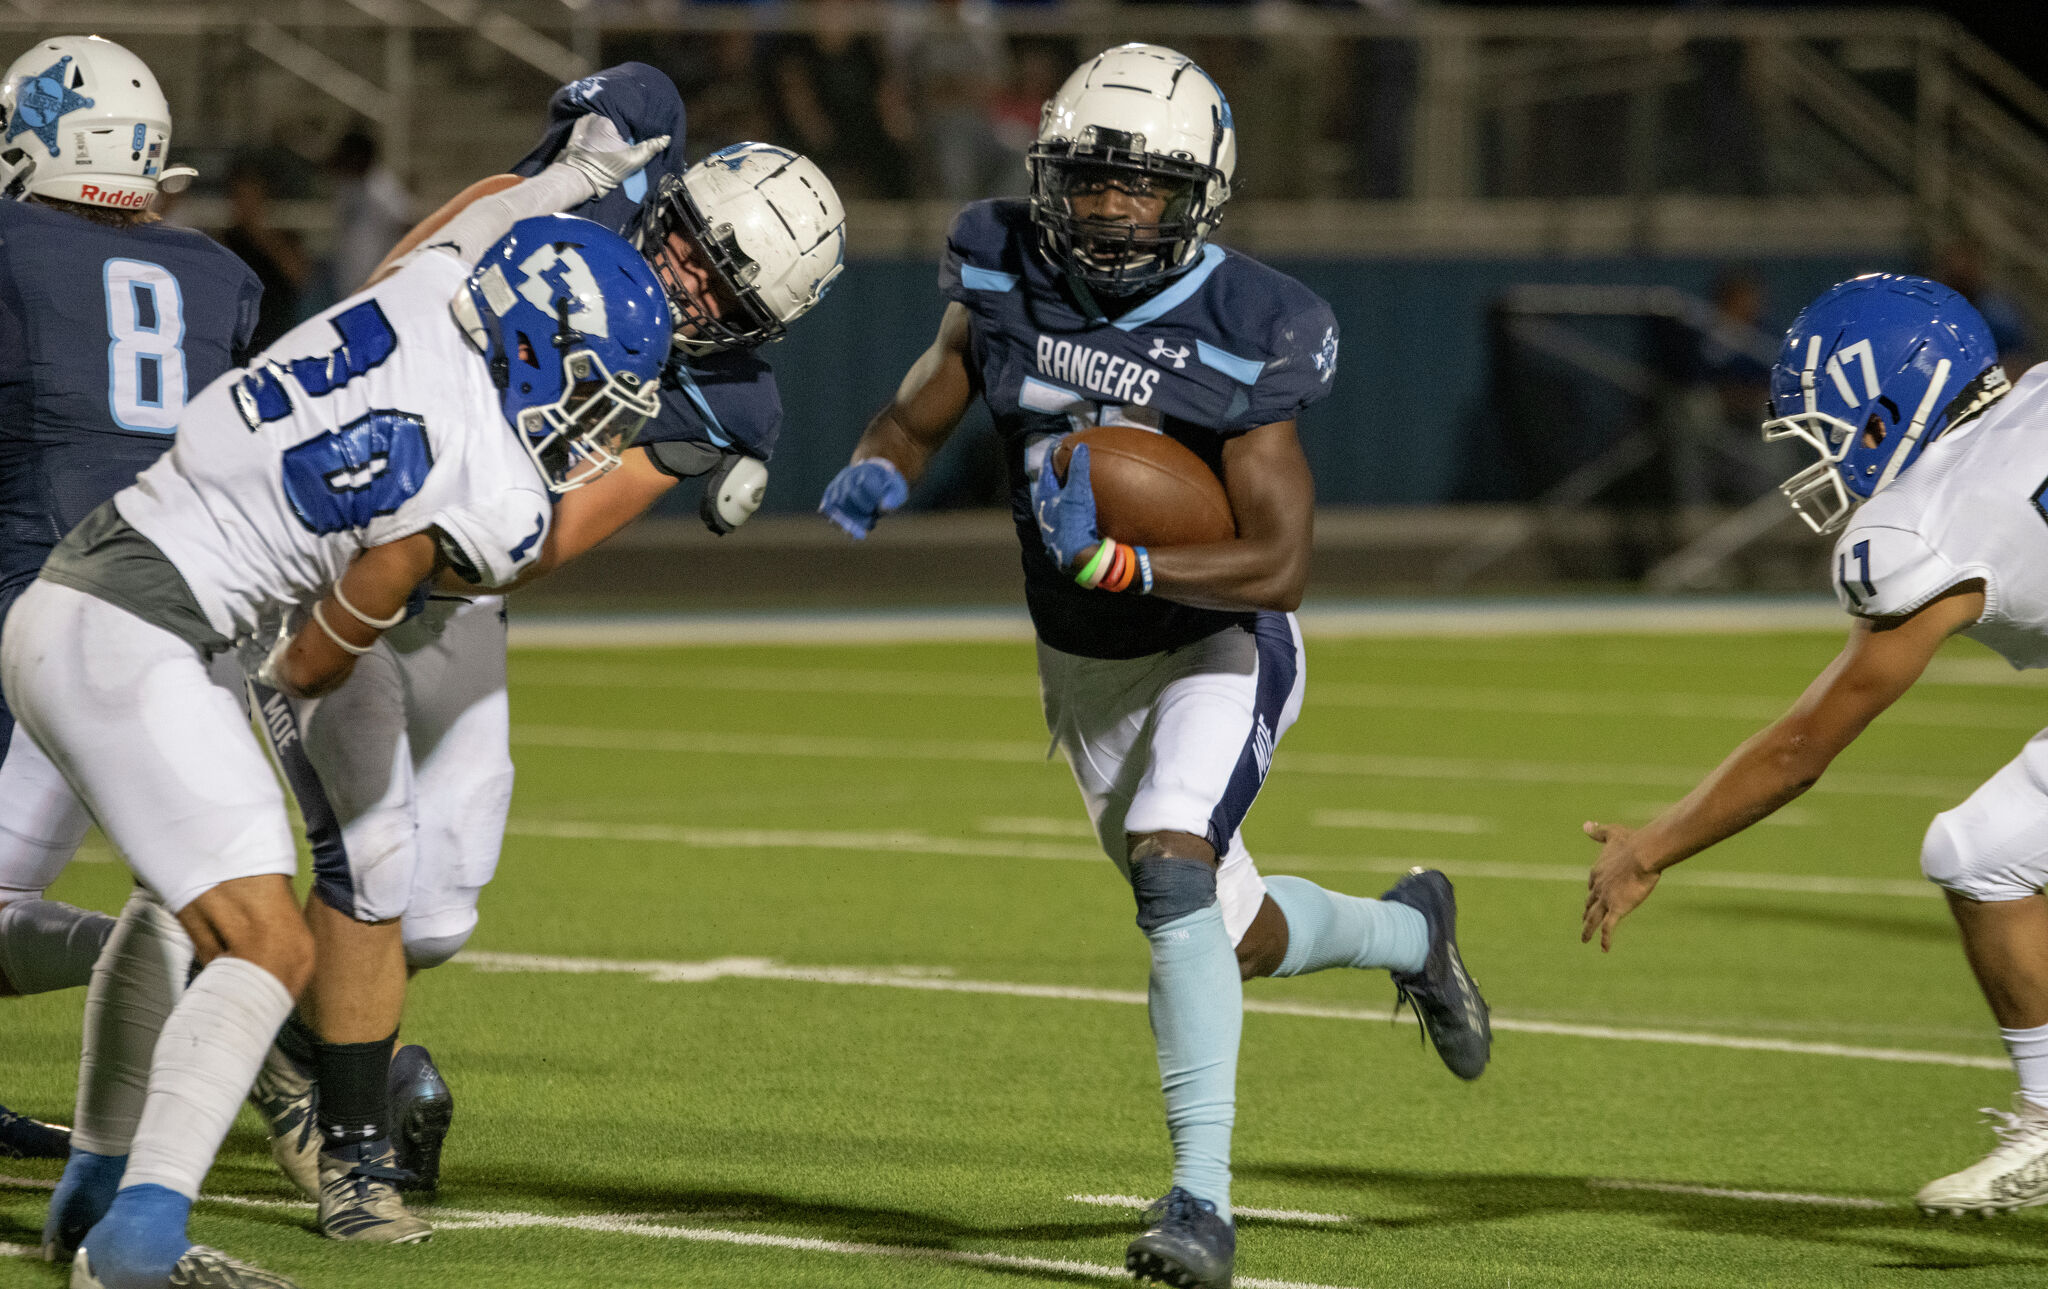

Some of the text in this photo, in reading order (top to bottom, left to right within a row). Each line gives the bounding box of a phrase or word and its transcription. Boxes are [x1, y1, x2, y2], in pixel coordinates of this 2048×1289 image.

[131, 122, 146, 151] 8
[80, 184, 153, 209] Riddell
[103, 257, 188, 434] 8
[1037, 334, 1160, 406] RANGERS
[1826, 338, 1881, 409] 17
